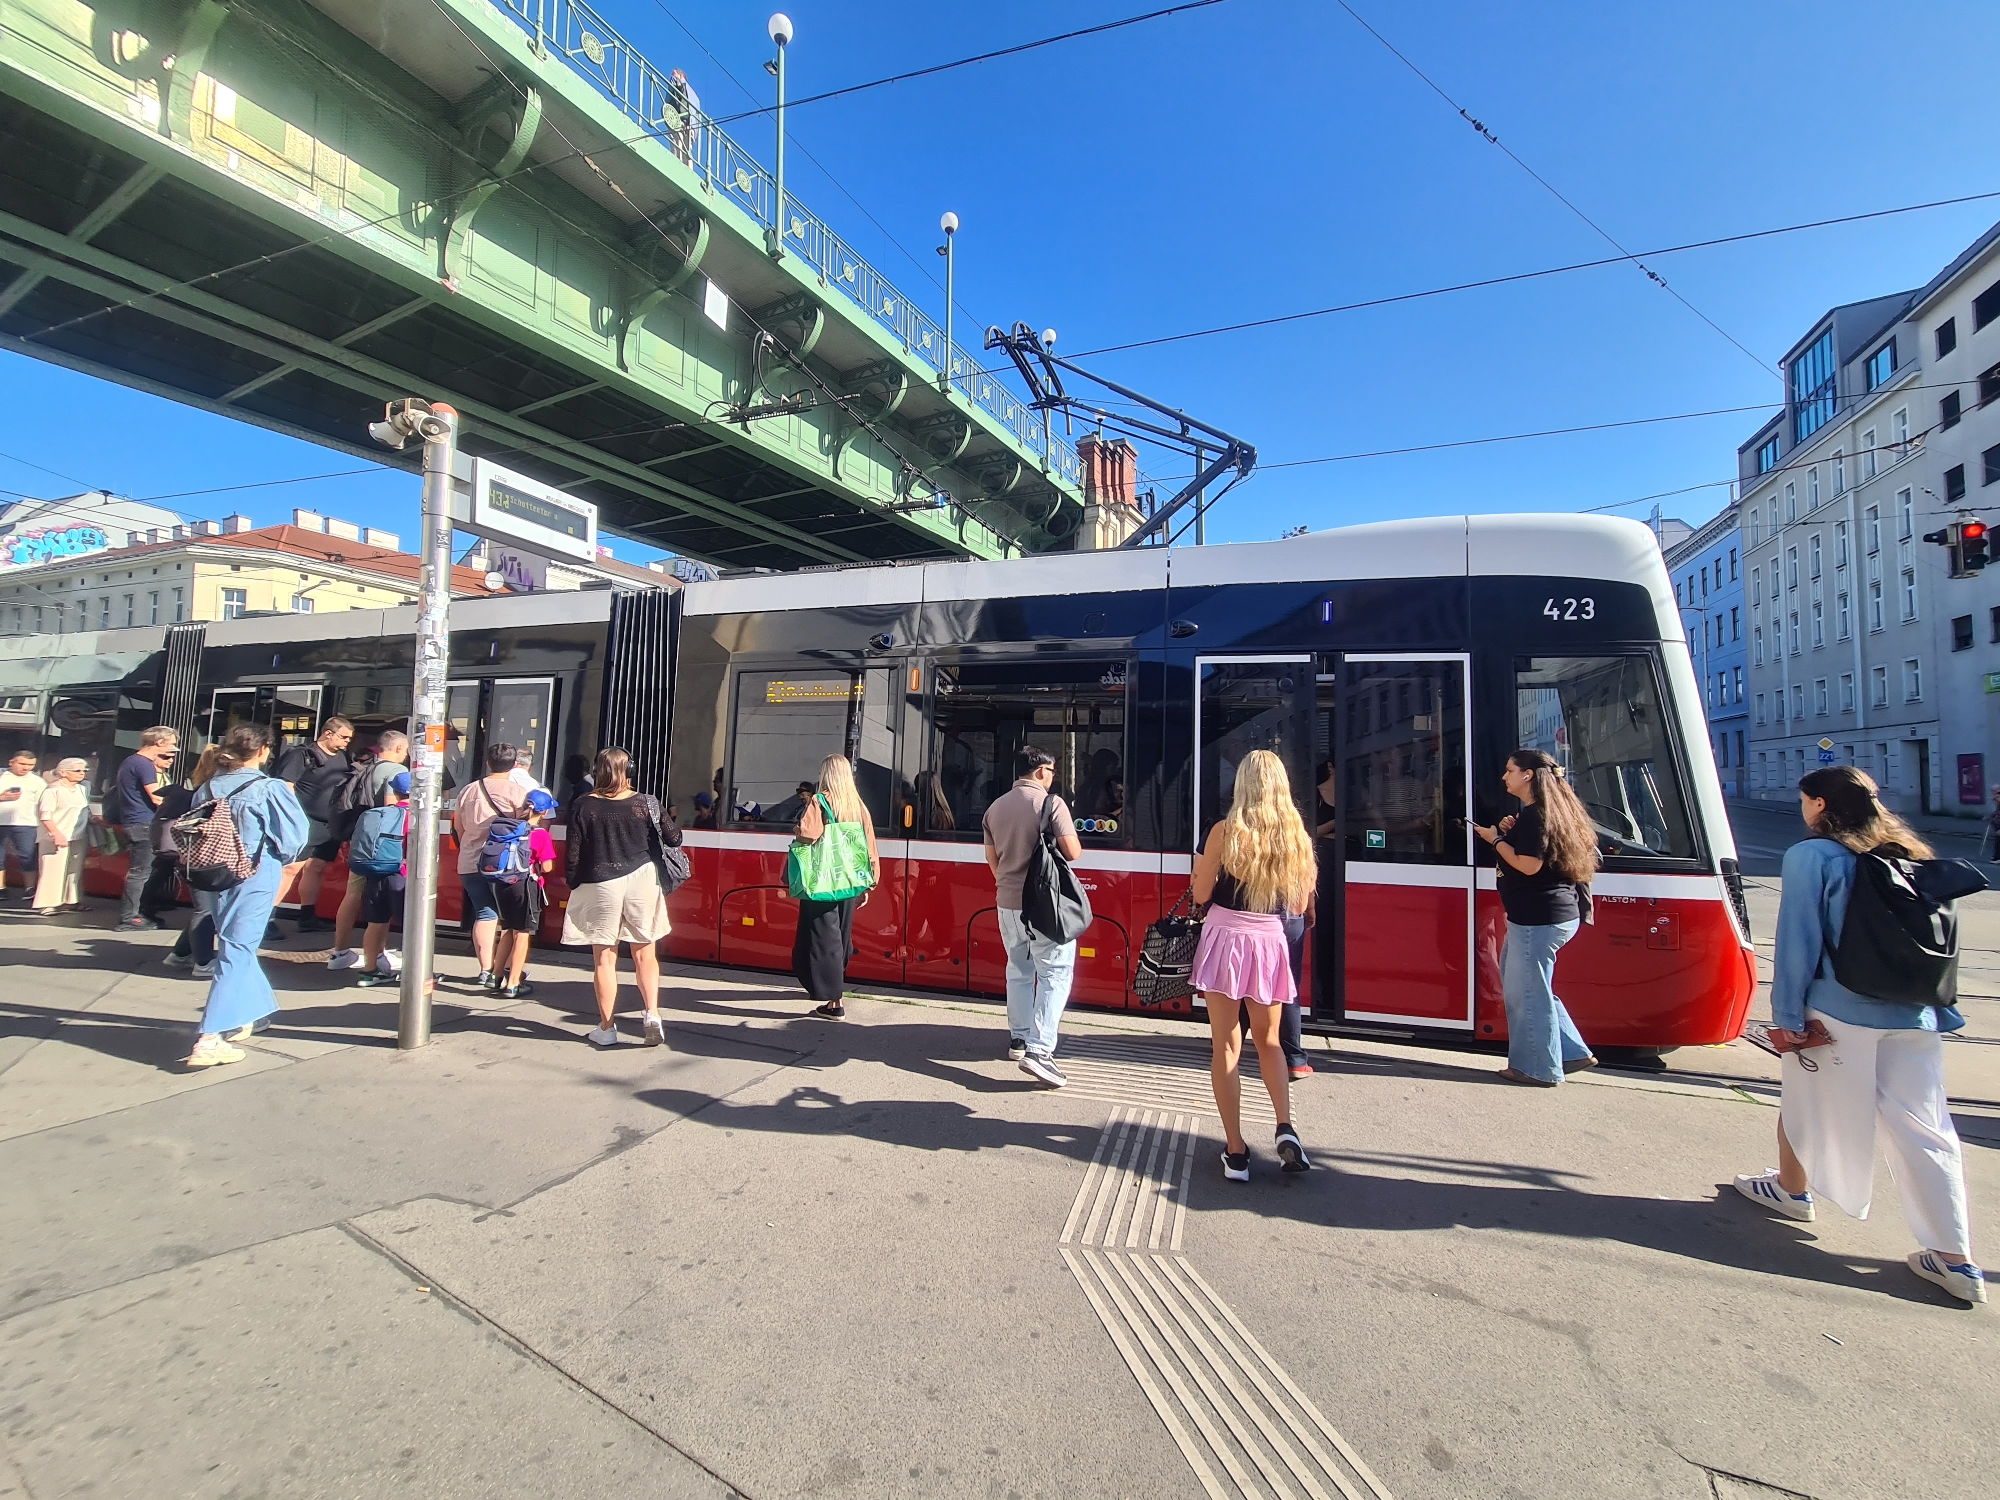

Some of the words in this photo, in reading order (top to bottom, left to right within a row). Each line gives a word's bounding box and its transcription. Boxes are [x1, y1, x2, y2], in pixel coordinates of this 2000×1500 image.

[489, 487, 503, 507] 43
[1543, 597, 1595, 621] 423
[1819, 752, 1834, 761] 221
[1601, 895, 1637, 904] ALSTOM
